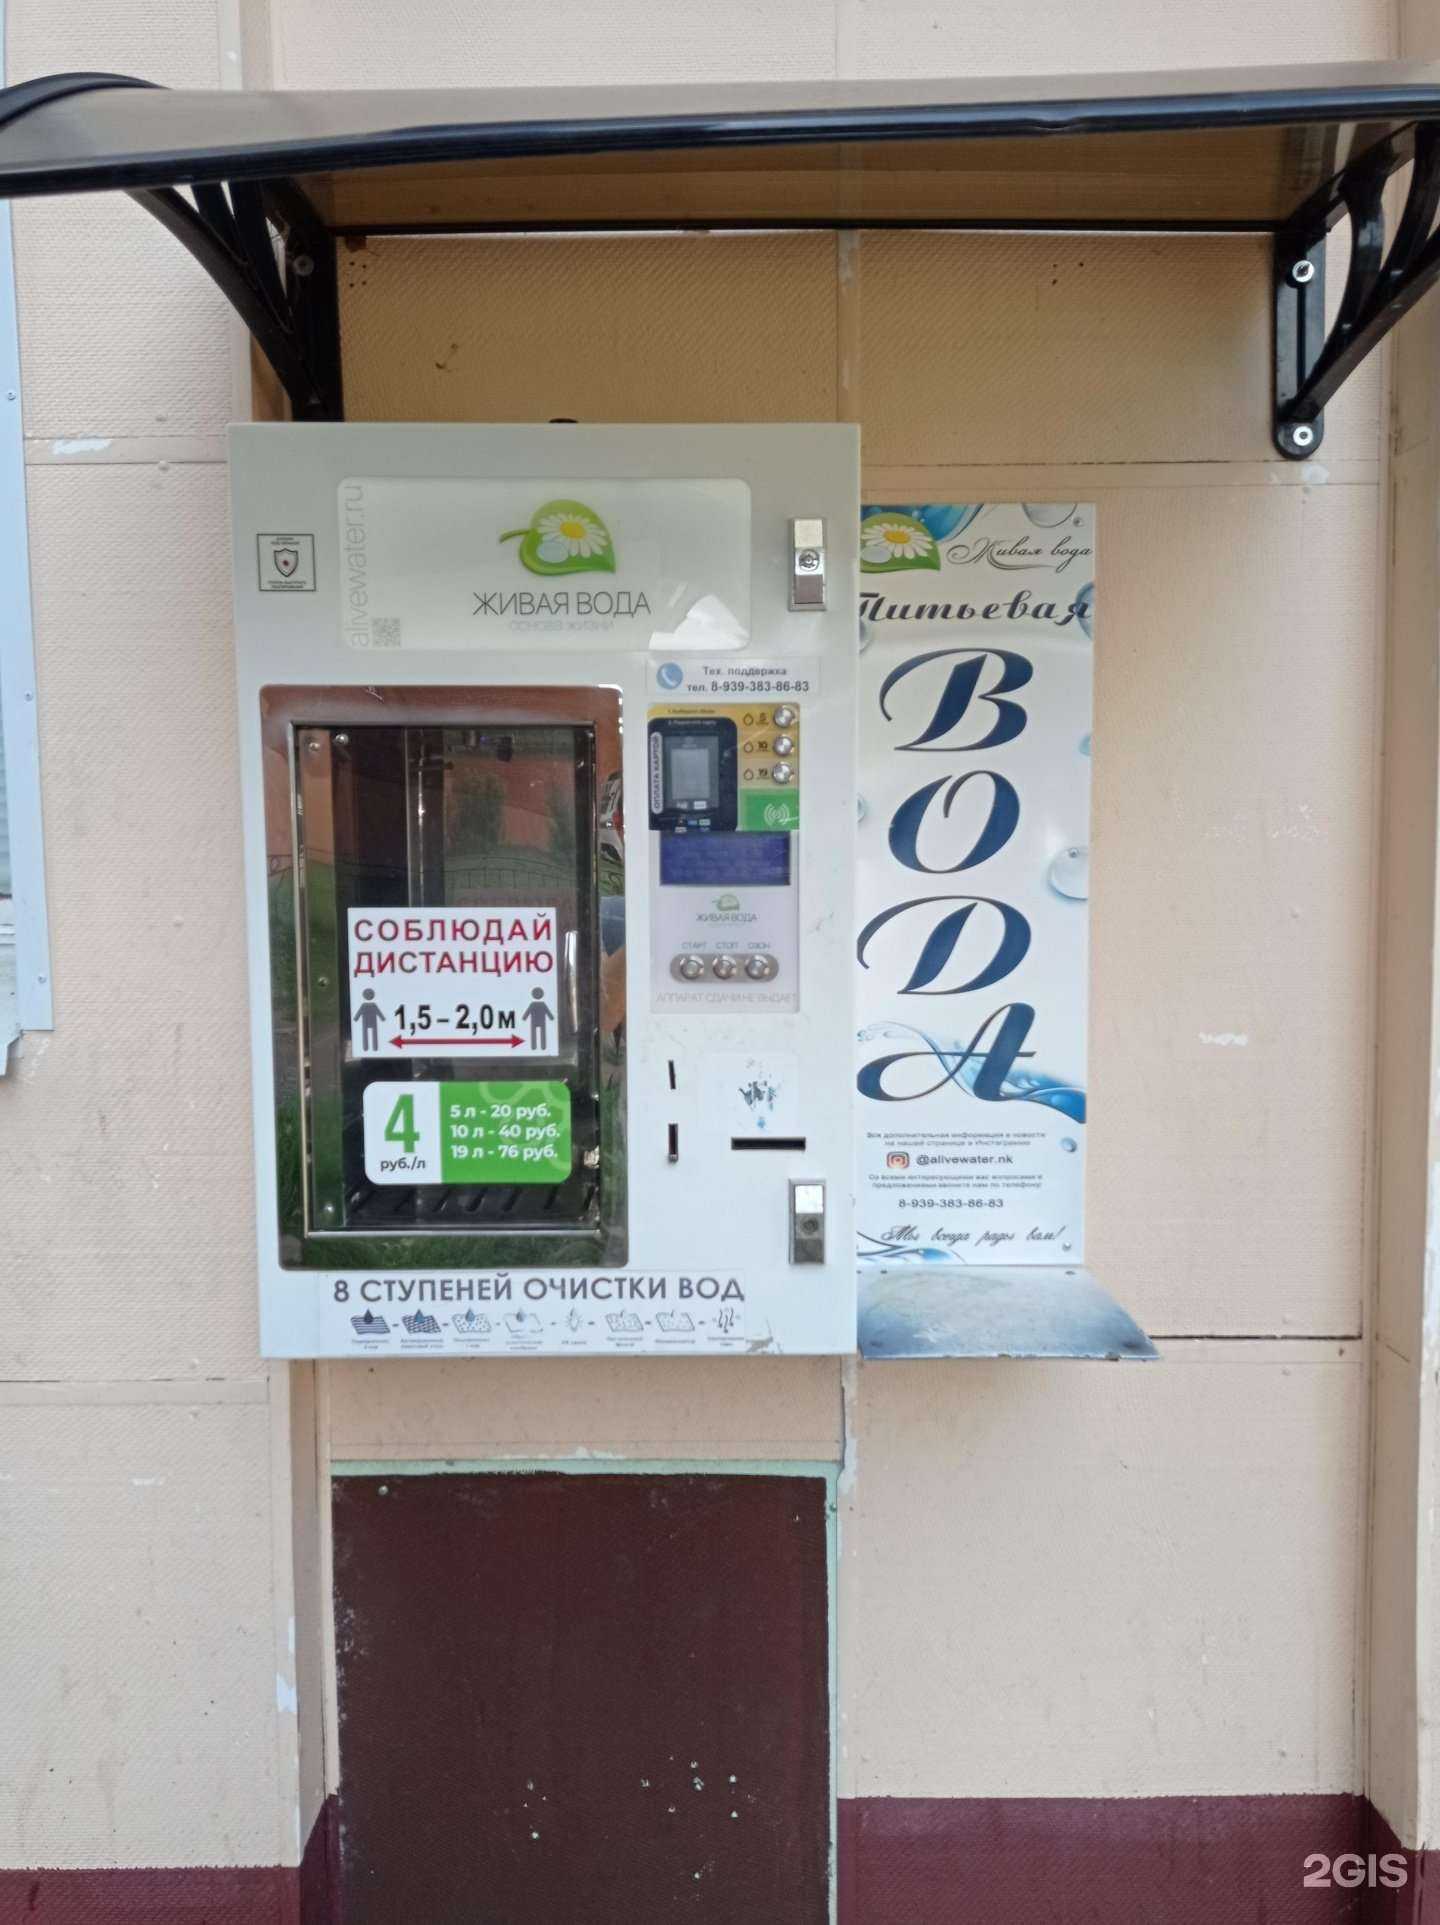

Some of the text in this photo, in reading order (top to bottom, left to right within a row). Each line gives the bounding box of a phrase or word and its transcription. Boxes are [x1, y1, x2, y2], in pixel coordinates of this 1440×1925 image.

[947, 536, 1094, 573] Живая вода
[343, 485, 369, 648] alivewater.ru
[472, 591, 651, 619] ЖИВАЯ ВОДА
[859, 590, 1093, 626] Питьевая
[703, 666, 787, 677] Тех. поддержка
[687, 681, 810, 692] тел. 8-939-383-86-83
[696, 914, 757, 923] ЖИВАЯ ВОДА
[354, 913, 552, 945] СОБЛЮДАЙ
[353, 951, 554, 977] ДИСТАНЦИЮ
[450, 1105, 461, 1118] 5
[464, 1107, 475, 1118] л
[490, 1104, 511, 1118] 20
[516, 1104, 551, 1120] руб.
[384, 1093, 420, 1153] 4
[450, 1124, 468, 1138] 10
[472, 1127, 484, 1138] л
[498, 1124, 521, 1138] 40
[525, 1124, 560, 1140] руб.
[450, 1145, 468, 1158] 19
[471, 1148, 484, 1158] л
[498, 1144, 518, 1158] 76
[523, 1144, 558, 1161] руб.
[916, 1154, 1013, 1166] @alivewater.nk
[380, 1157, 426, 1171] руб./л
[898, 1199, 1004, 1209] 8-939-383-86-83
[880, 1225, 1067, 1247] Мы всегда рады вам!
[333, 1272, 745, 1302] 8 СТУПЕНЕЙ ОЧИСТКИ ВОД
